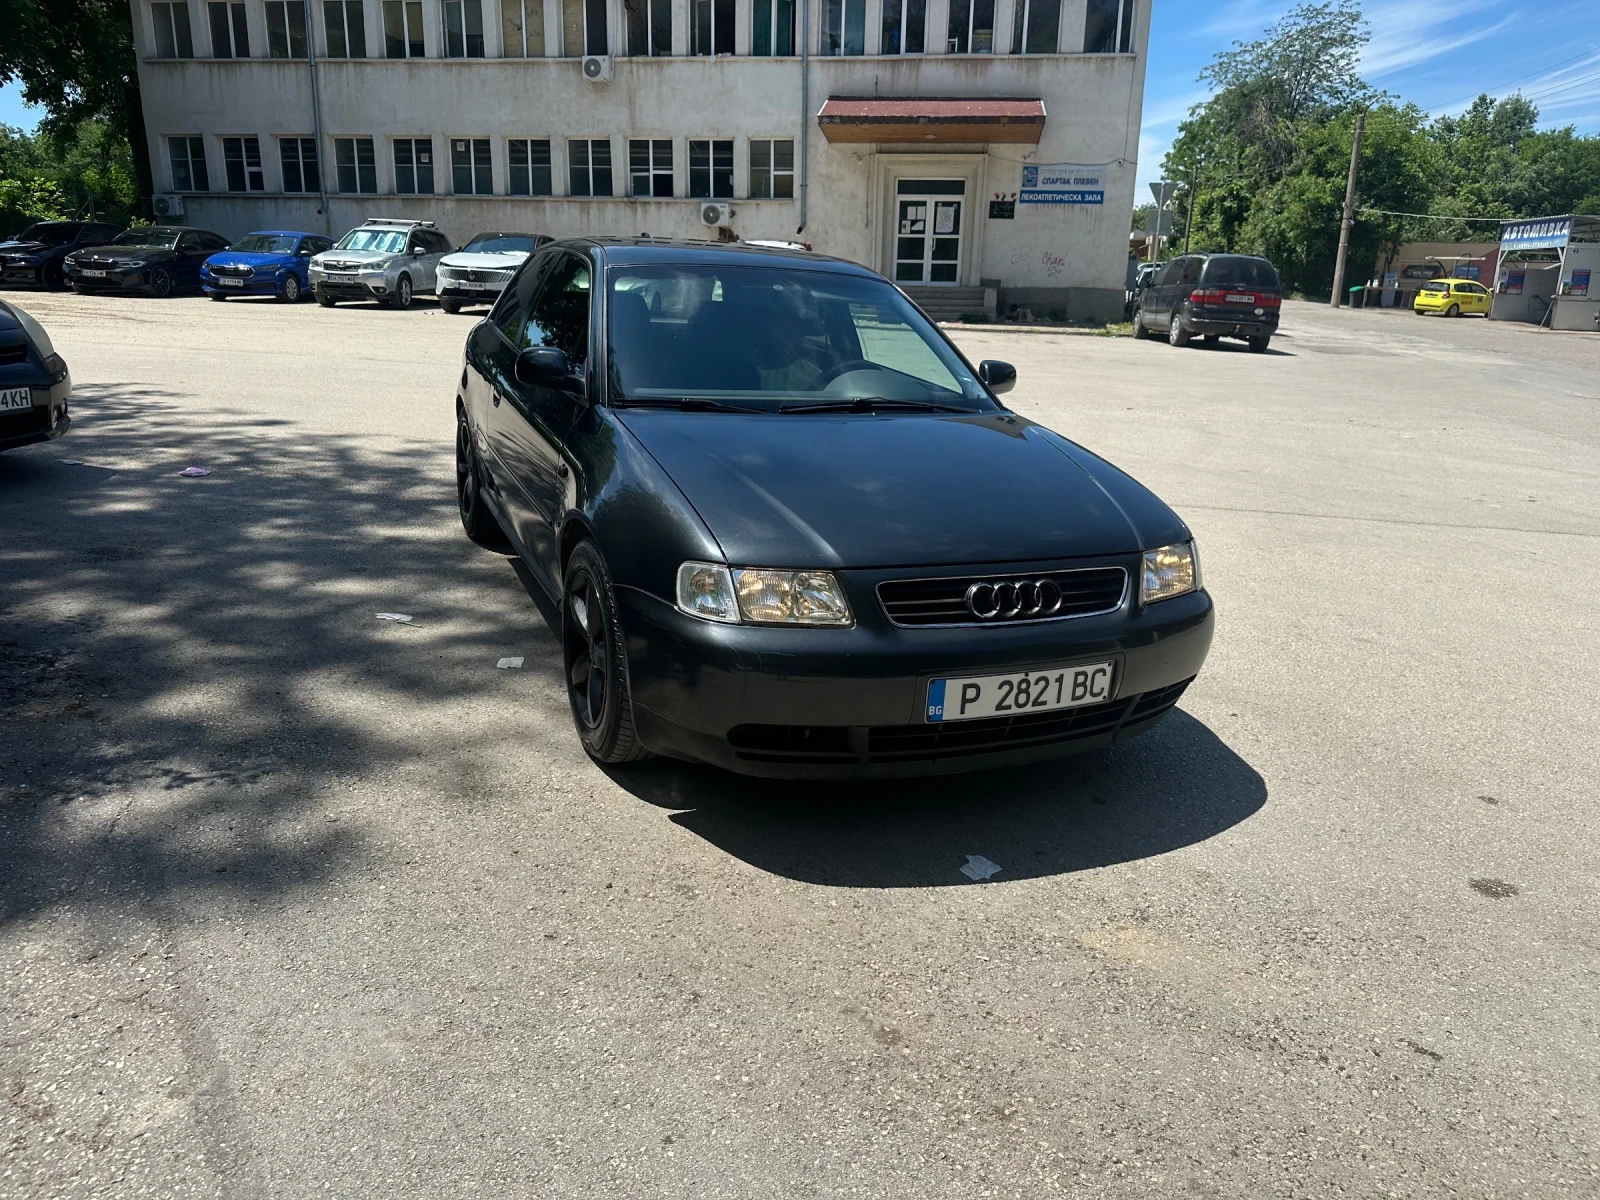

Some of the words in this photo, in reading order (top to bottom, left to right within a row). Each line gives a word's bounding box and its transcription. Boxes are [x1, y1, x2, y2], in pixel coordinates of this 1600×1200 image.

[1042, 177, 1071, 186] СПАРТАК
[1073, 178, 1099, 186] ПЛЕВЕН
[1020, 193, 1082, 201] ЛЕКОАТЛЕТИЧЕСКА
[1503, 220, 1570, 240] АВТОМИВКА
[959, 683, 981, 715] P
[994, 673, 1065, 712] 2821
[1071, 667, 1107, 702] BC
[928, 705, 942, 716] BG
